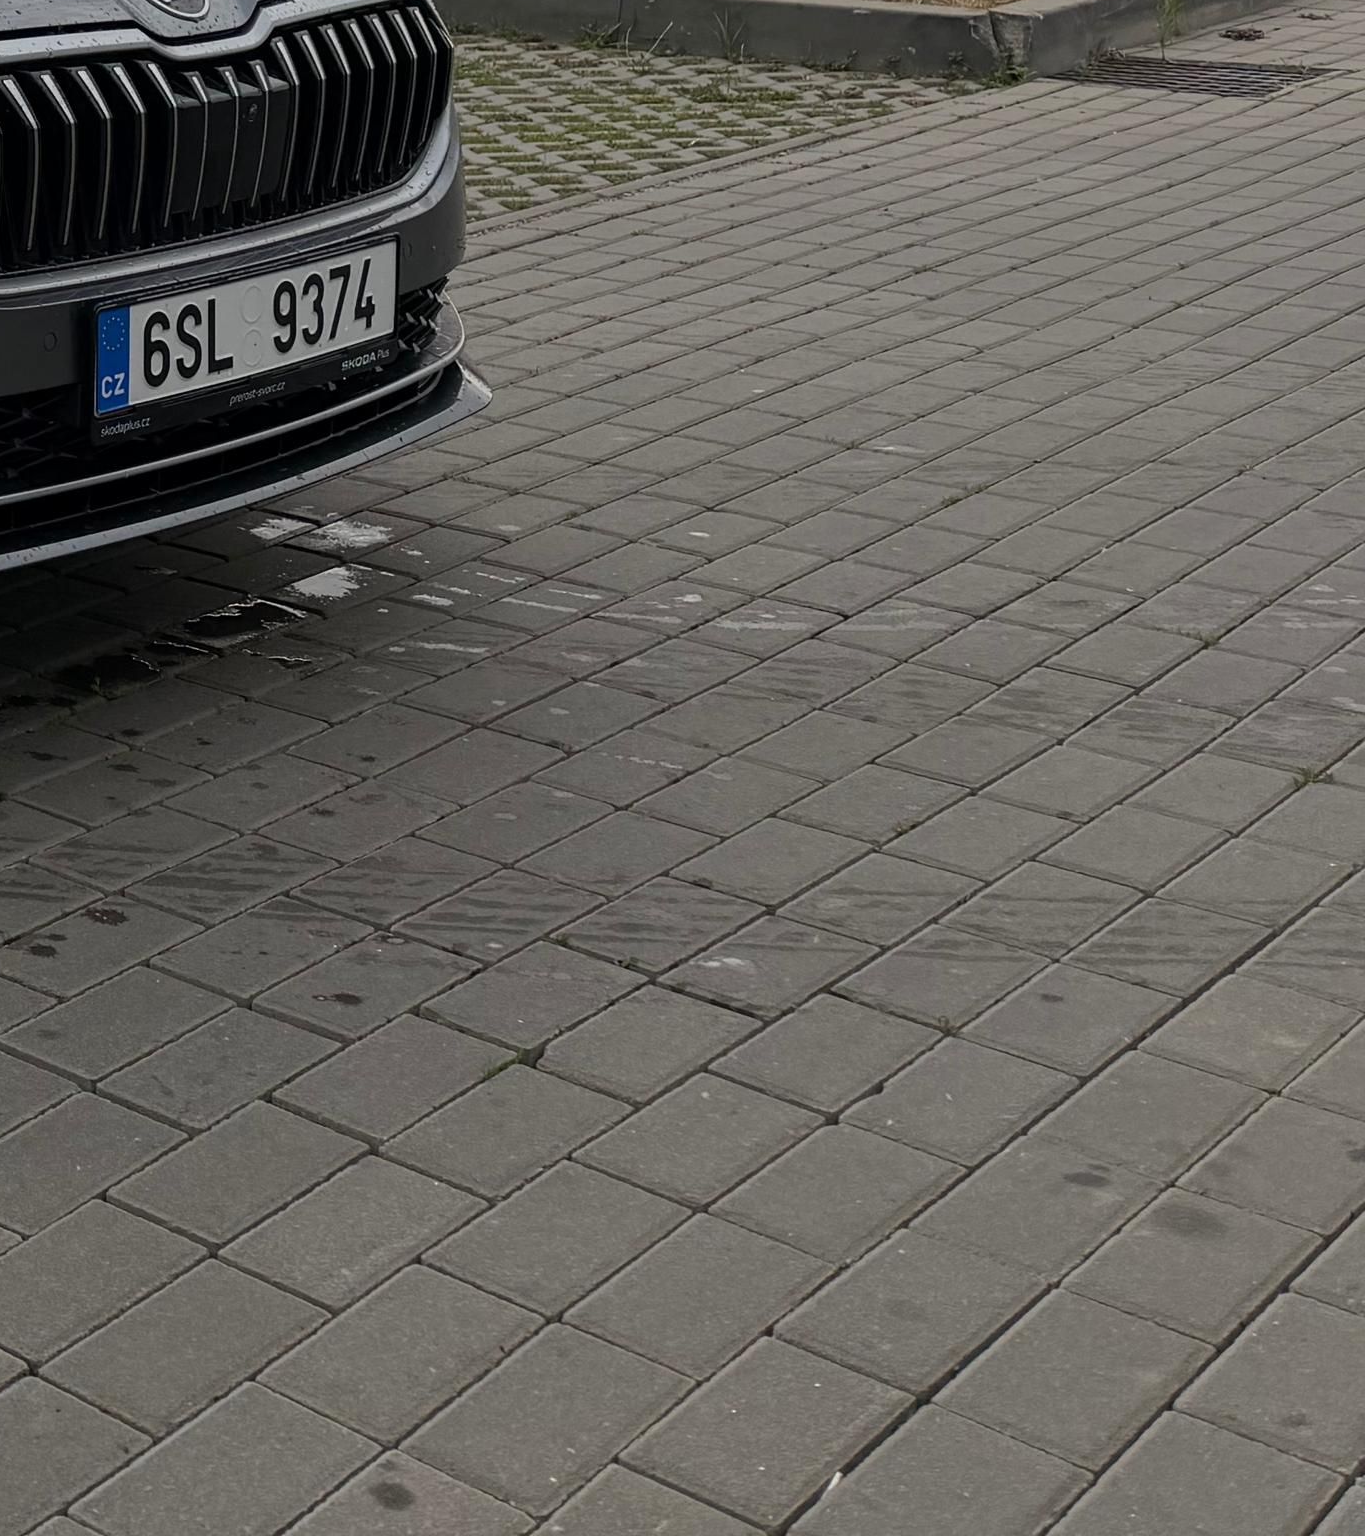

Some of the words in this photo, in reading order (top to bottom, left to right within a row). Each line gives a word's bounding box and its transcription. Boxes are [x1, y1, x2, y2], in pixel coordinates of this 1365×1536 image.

[143, 298, 234, 388] 6SL
[273, 258, 376, 354] 9374
[101, 372, 126, 399] CZ
[100, 417, 151, 438] skodaplus.cz
